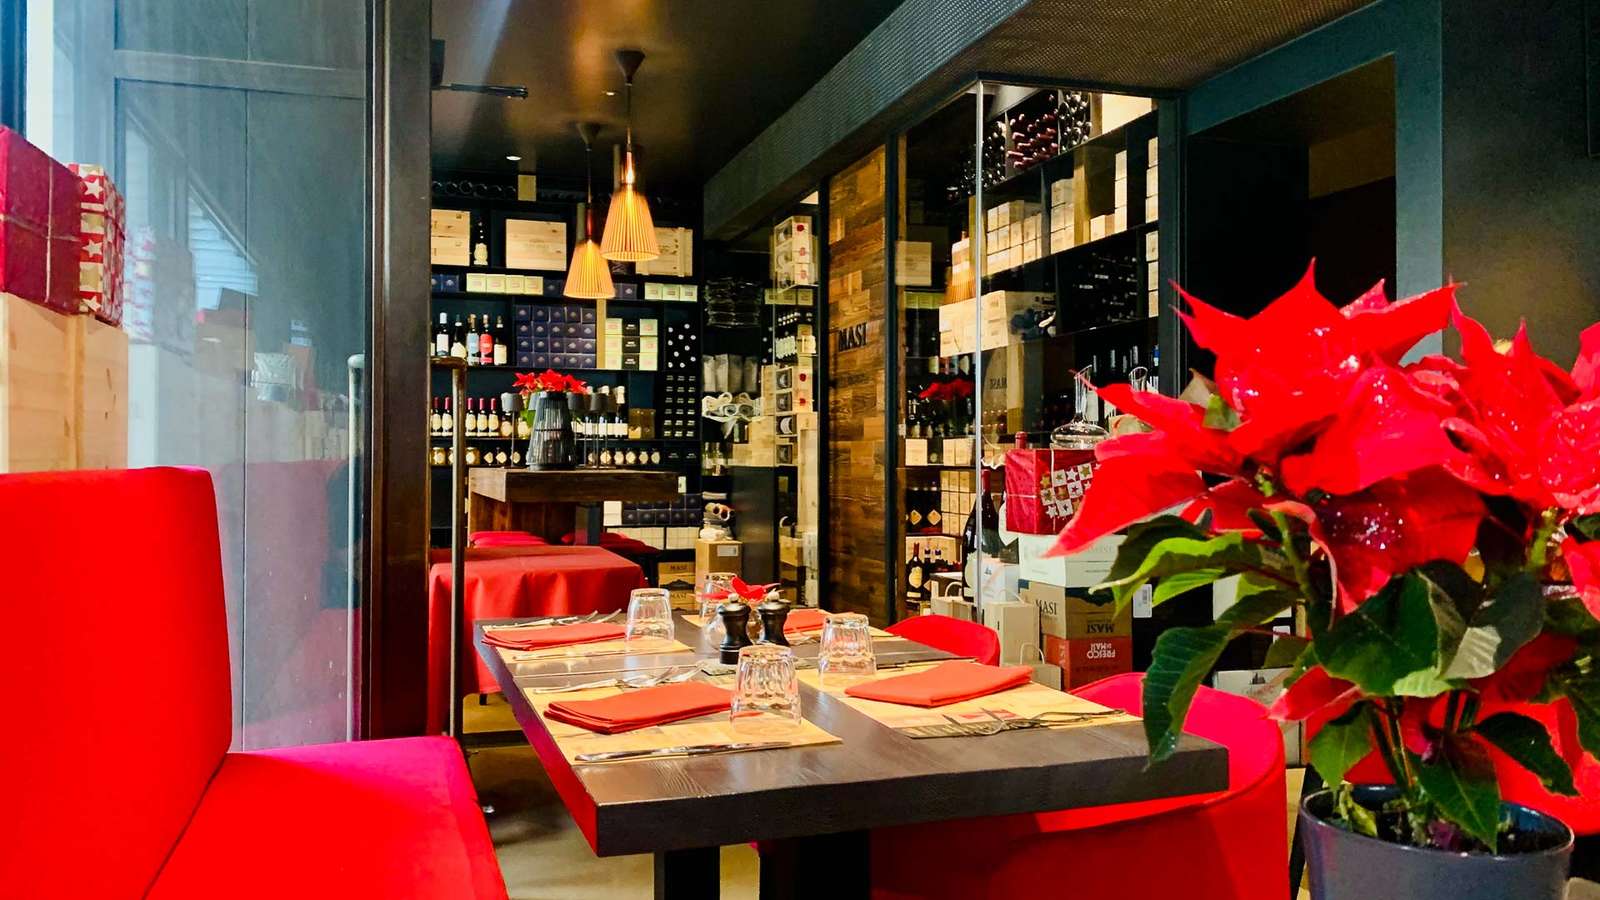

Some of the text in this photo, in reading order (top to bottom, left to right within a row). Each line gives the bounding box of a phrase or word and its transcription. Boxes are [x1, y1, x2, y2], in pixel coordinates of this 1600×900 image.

[838, 322, 867, 352] MASI
[1087, 623, 1115, 633] MASI
[1086, 649, 1116, 659] FRESCO
